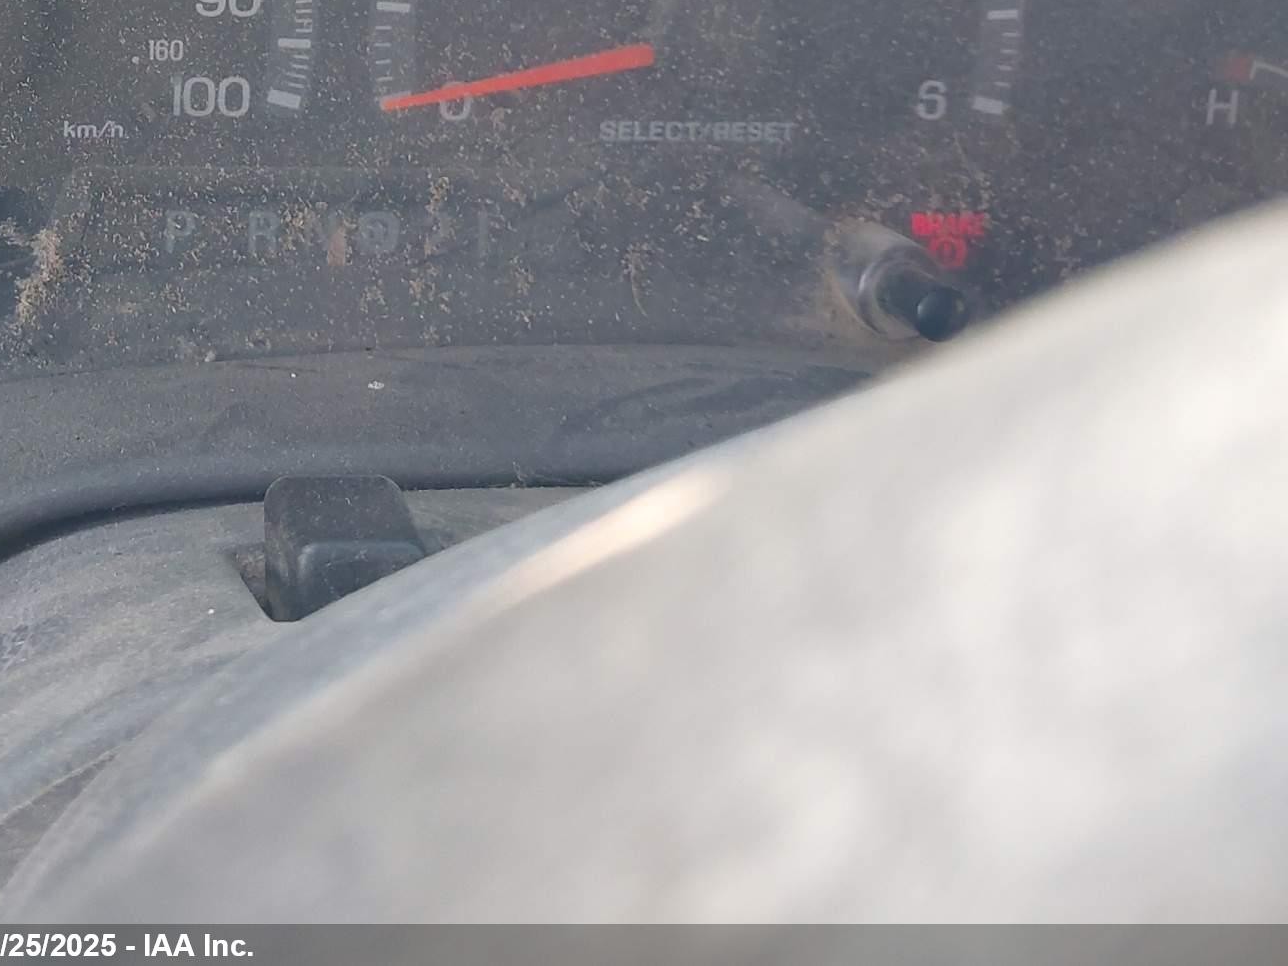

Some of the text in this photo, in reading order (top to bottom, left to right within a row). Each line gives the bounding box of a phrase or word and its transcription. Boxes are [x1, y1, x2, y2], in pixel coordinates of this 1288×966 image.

[148, 39, 184, 62] 160
[171, 75, 250, 117] 100
[916, 80, 947, 120] 6
[1206, 88, 1239, 125] H
[63, 120, 125, 139] km/h
